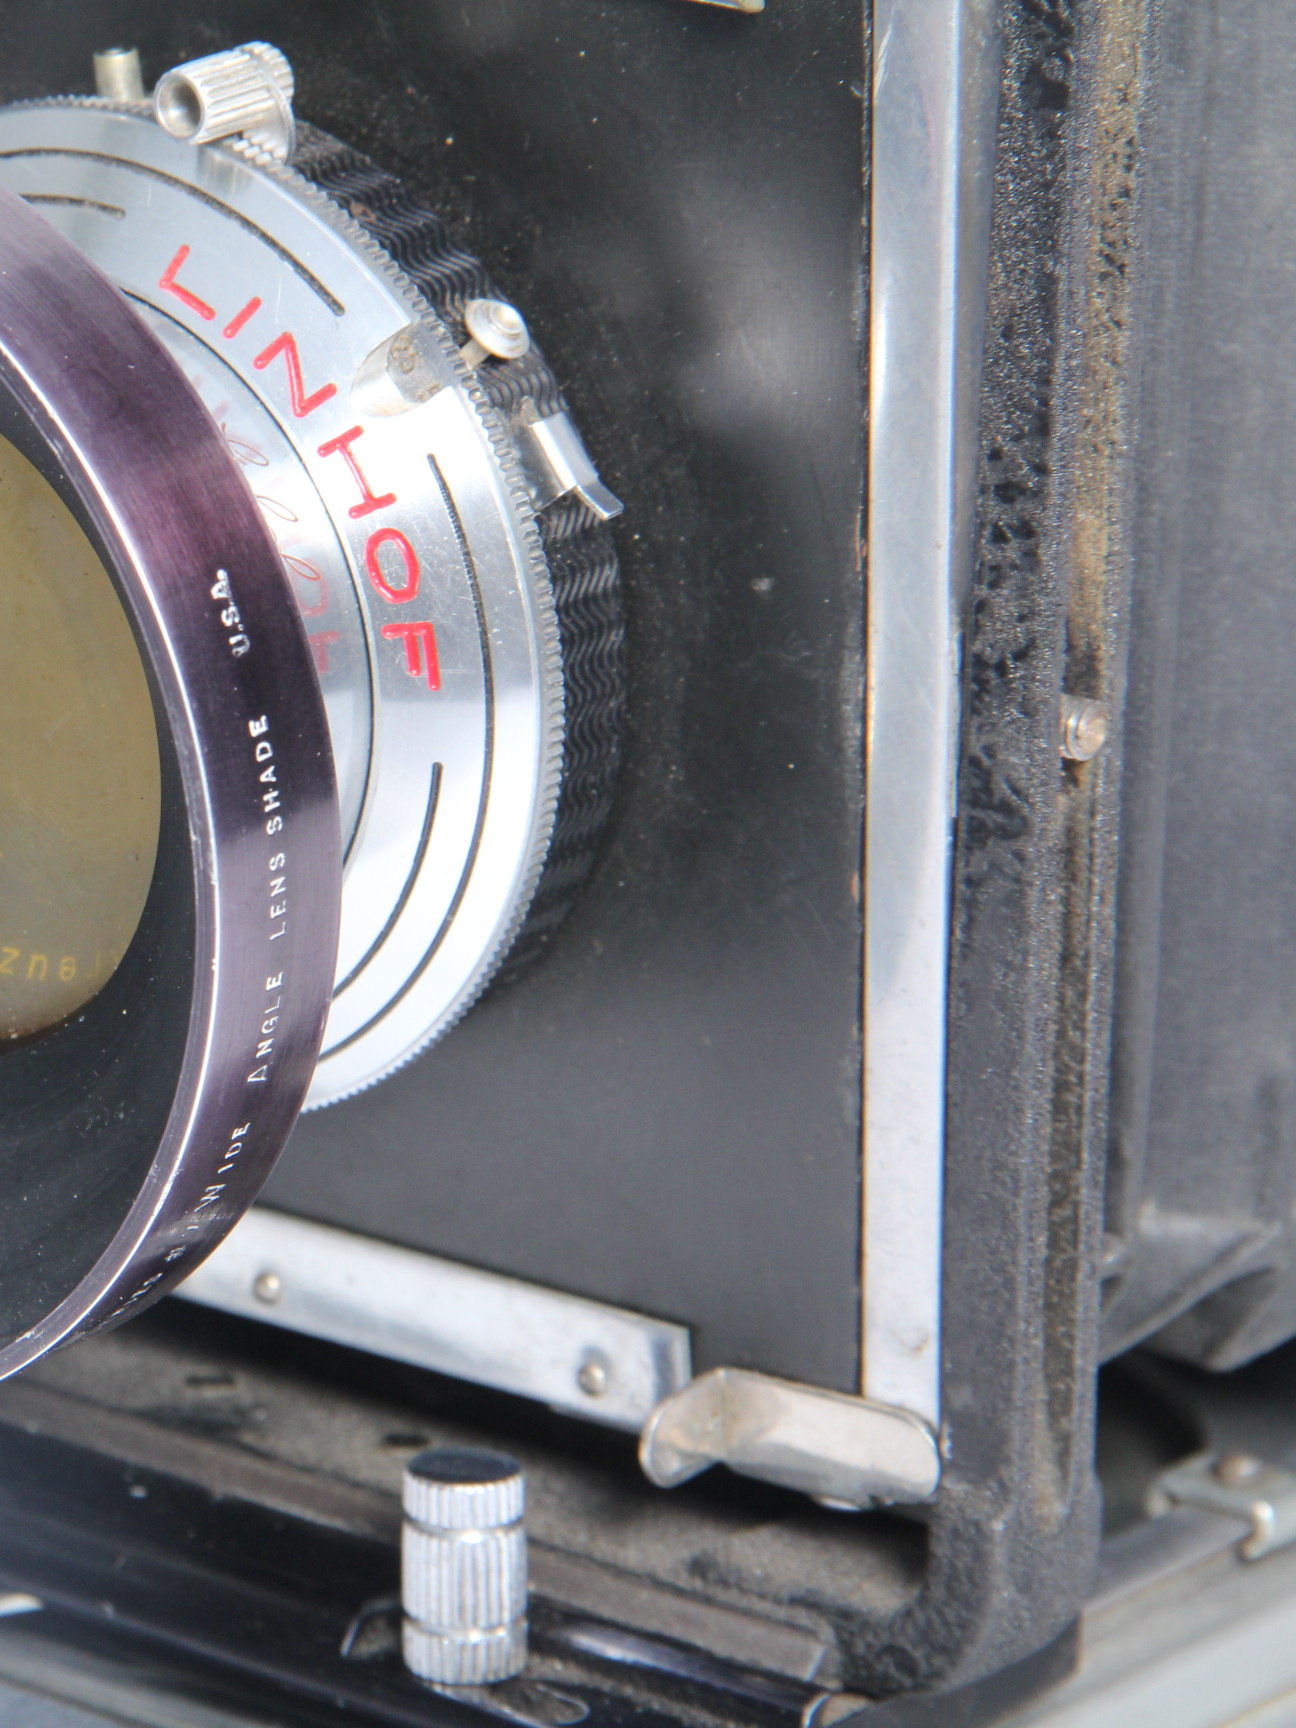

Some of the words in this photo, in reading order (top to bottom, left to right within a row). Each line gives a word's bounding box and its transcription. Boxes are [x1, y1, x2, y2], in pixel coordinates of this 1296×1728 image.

[158, 243, 442, 692] LINHOF
[248, 713, 285, 836] SHADE
[268, 852, 288, 941] LENS
[247, 971, 284, 1084] ANGLE
[194, 1121, 251, 1214] WIDE
